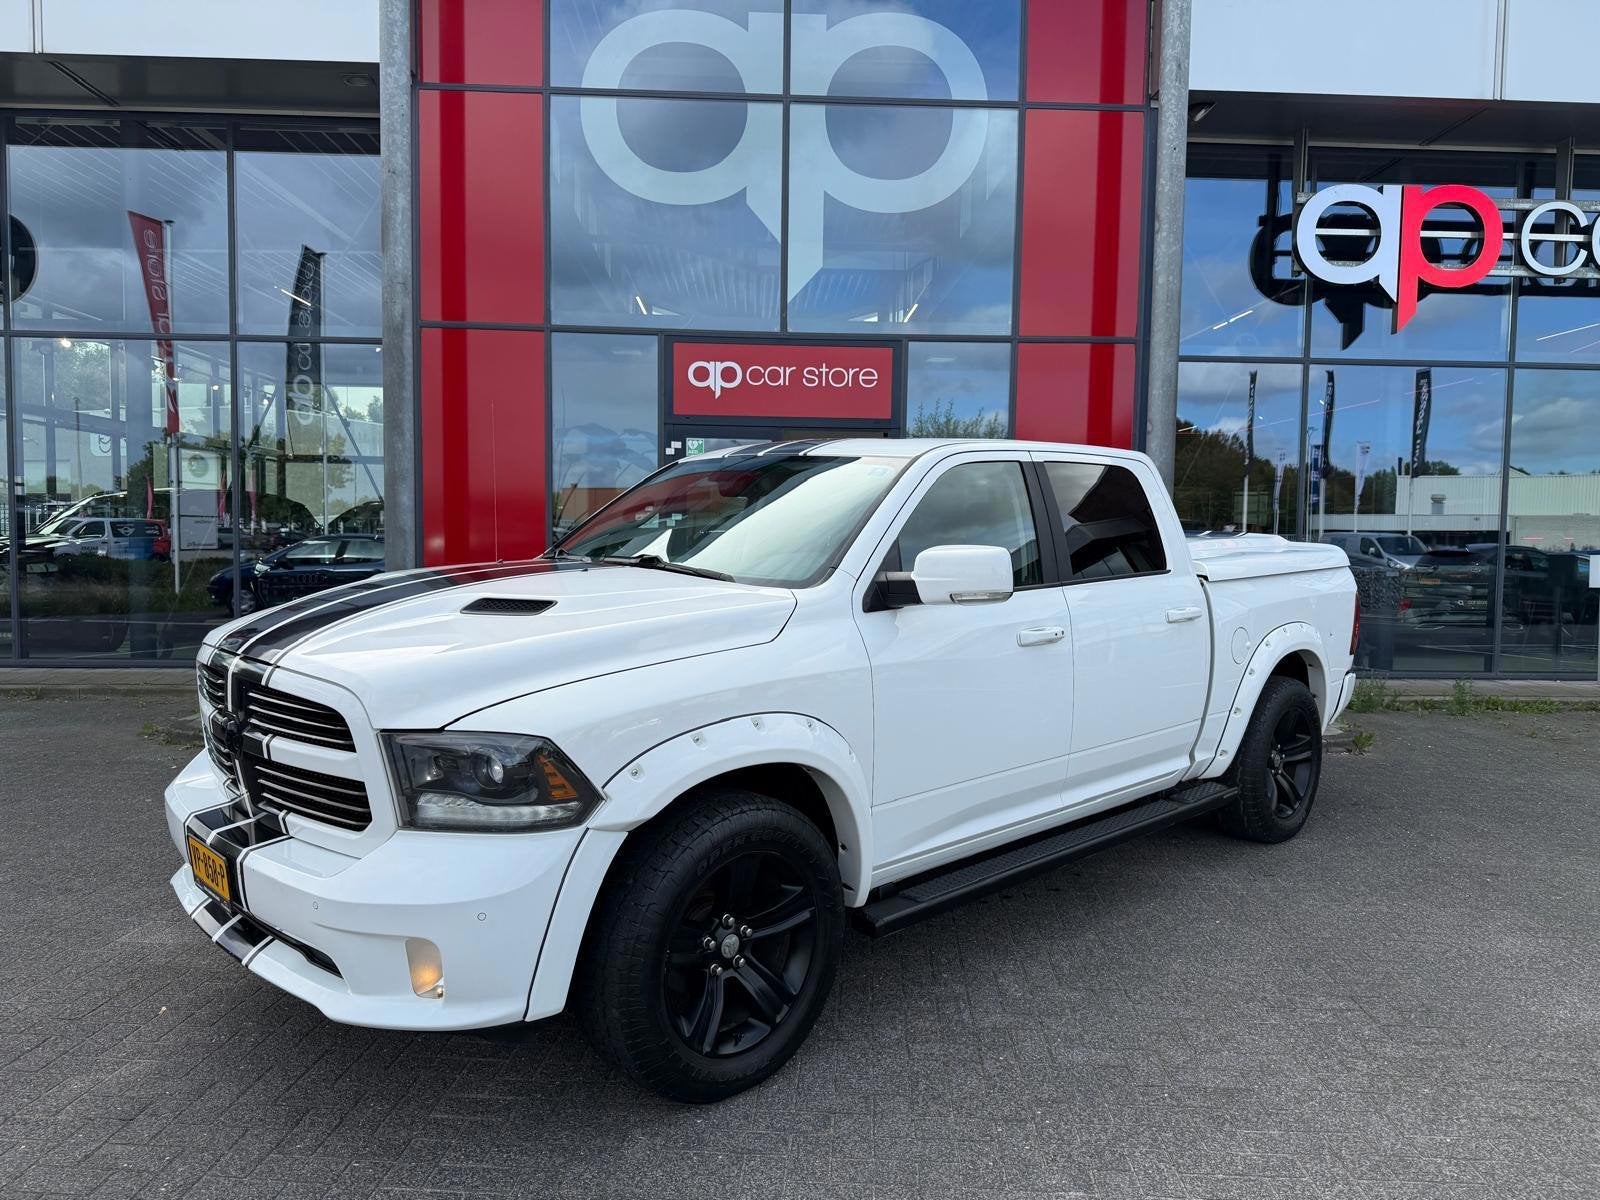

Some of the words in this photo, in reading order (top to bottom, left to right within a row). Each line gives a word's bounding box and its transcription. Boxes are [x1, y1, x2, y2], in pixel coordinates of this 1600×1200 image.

[580, 9, 989, 304] ap
[1296, 184, 1504, 334] ap
[687, 360, 743, 399] ap
[746, 365, 797, 387] car
[803, 362, 879, 389] store
